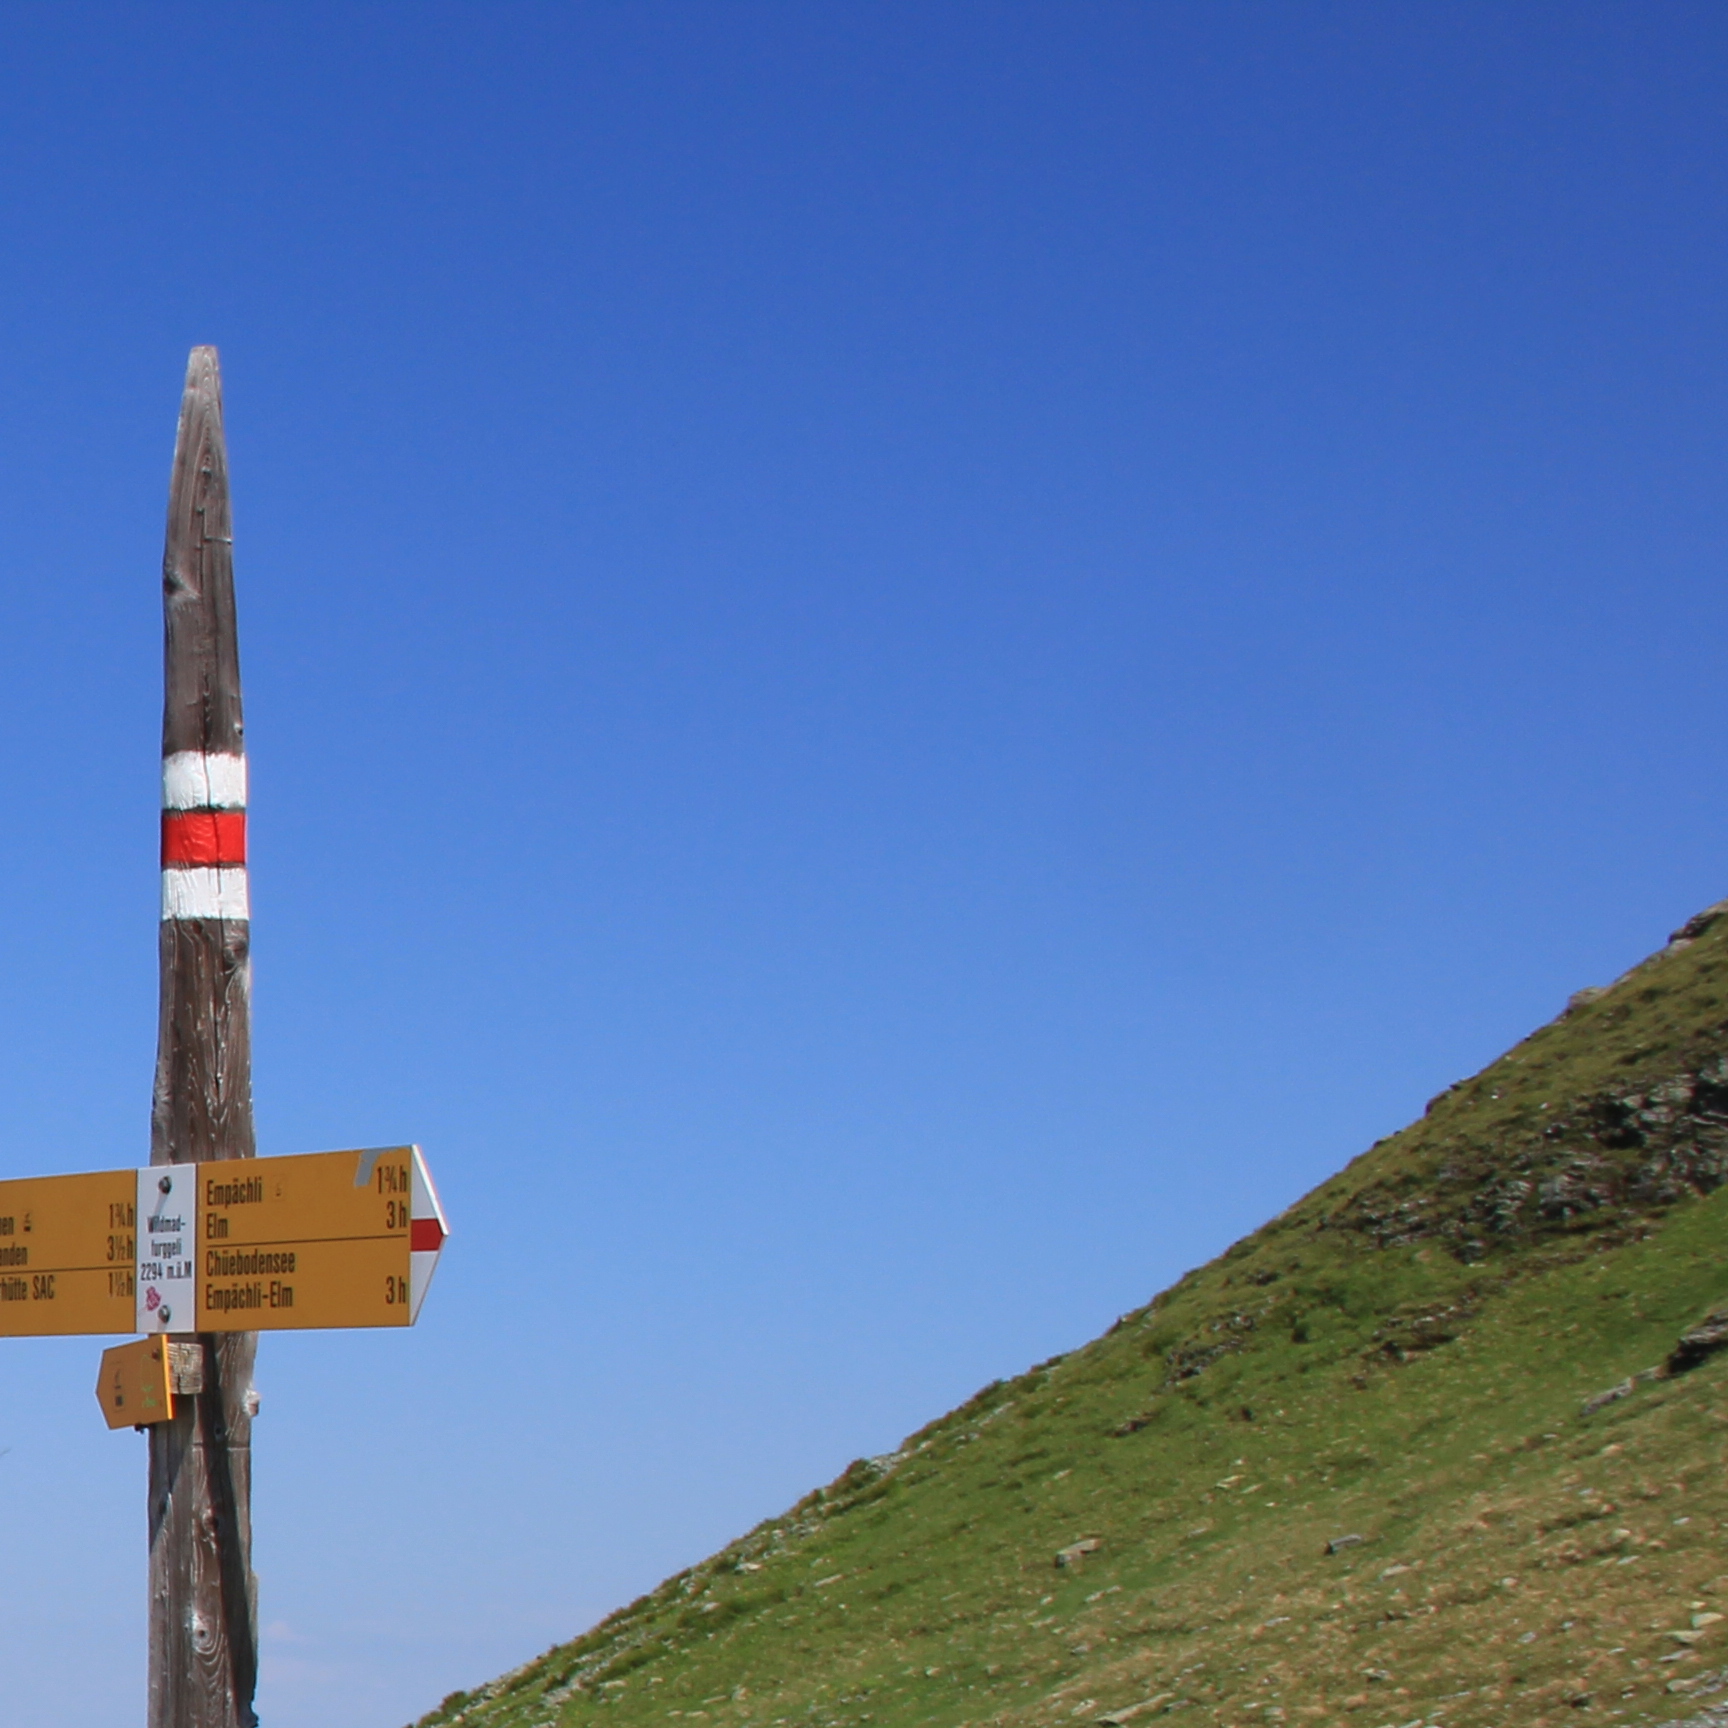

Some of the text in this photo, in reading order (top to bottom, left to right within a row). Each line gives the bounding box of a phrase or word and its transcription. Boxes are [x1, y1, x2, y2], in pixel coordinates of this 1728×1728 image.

[206, 1176, 262, 1209] Empächli
[399, 1165, 407, 1192] h
[147, 1214, 185, 1233] Wildmad-
[206, 1200, 407, 1239] Elm 3 h
[151, 1238, 182, 1259] furggeli
[141, 1263, 162, 1281] 2294
[206, 1248, 295, 1276] Chüebodensee
[33, 1275, 54, 1300] SAC
[206, 1275, 406, 1314] Empächli-Elm 3 h
